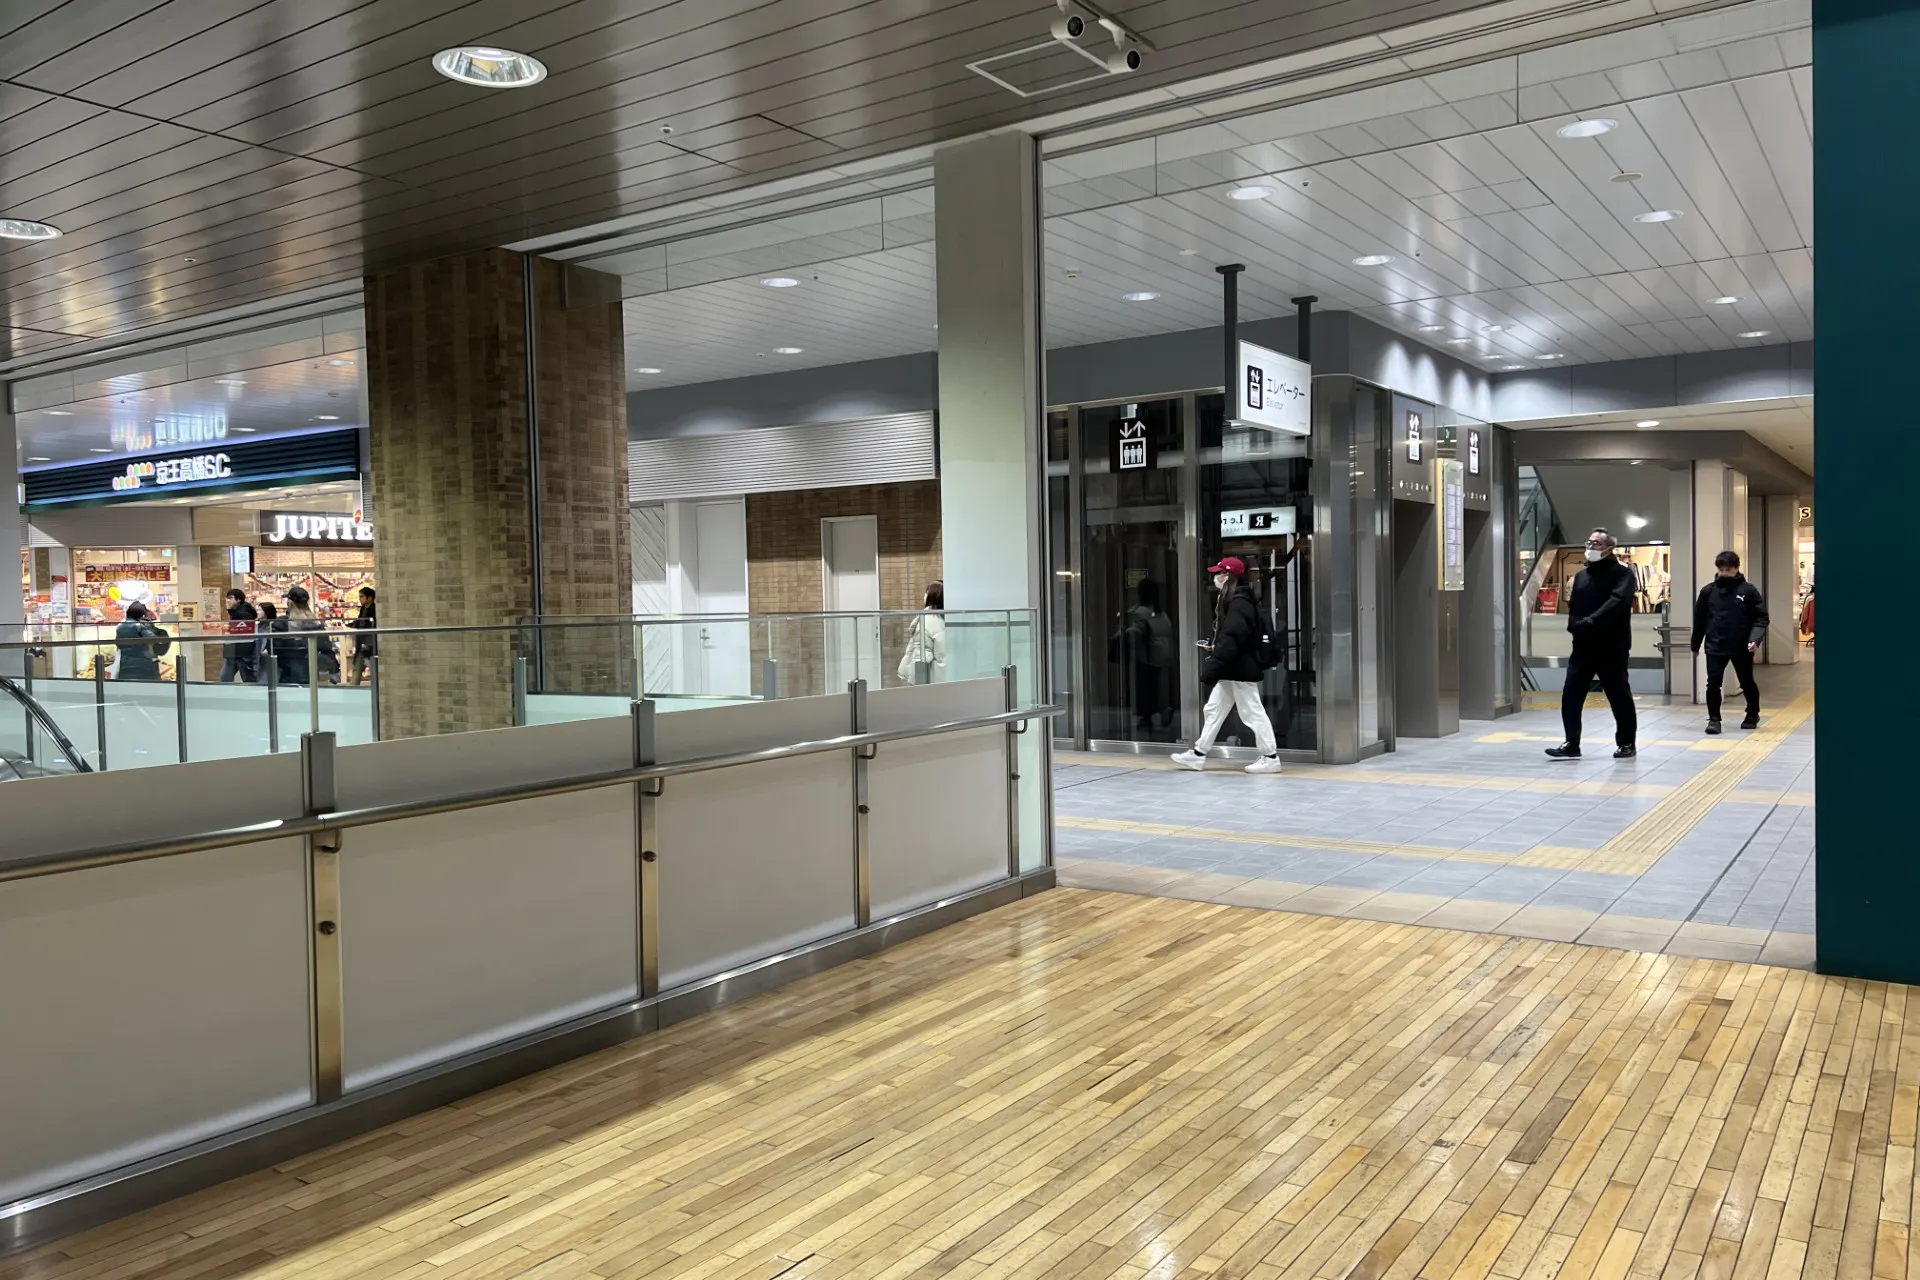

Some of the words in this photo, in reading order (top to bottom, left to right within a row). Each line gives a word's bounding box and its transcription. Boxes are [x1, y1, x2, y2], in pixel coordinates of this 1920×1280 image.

[1266, 378, 1305, 399] エレベーター
[155, 453, 231, 484] 京王高幡SC
